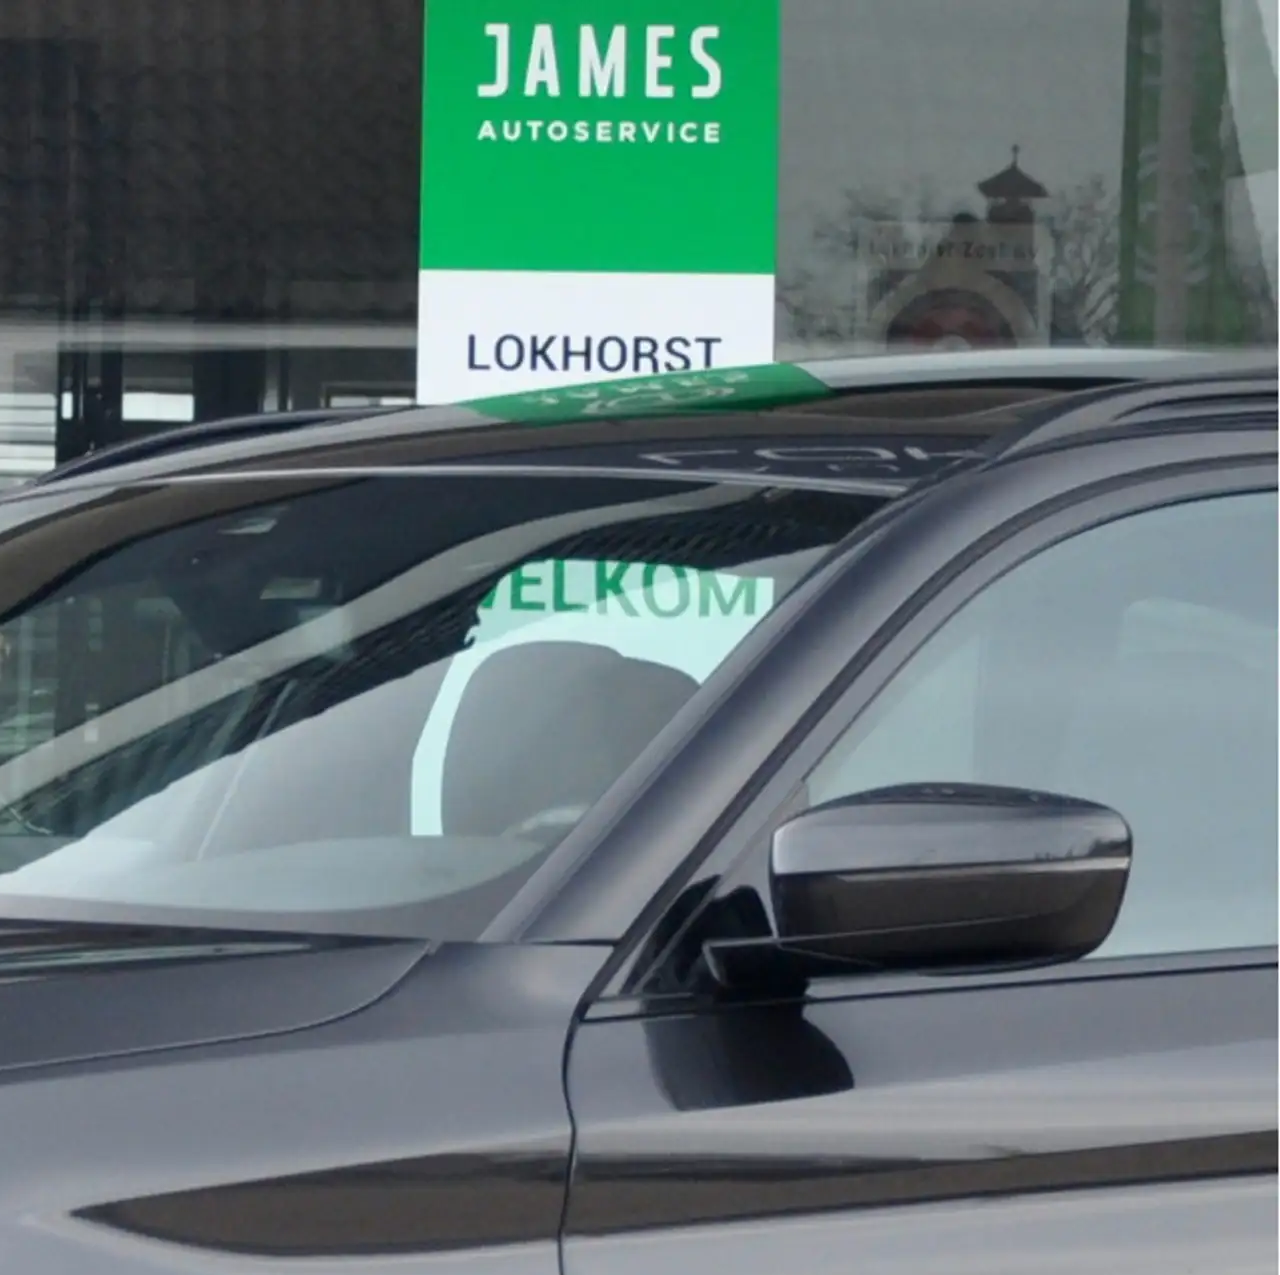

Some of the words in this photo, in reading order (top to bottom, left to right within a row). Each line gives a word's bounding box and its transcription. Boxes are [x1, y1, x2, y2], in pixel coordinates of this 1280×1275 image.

[477, 22, 723, 99] JAMES
[477, 119, 722, 144] AUTOSERVICE
[467, 333, 723, 374] LOKHORST
